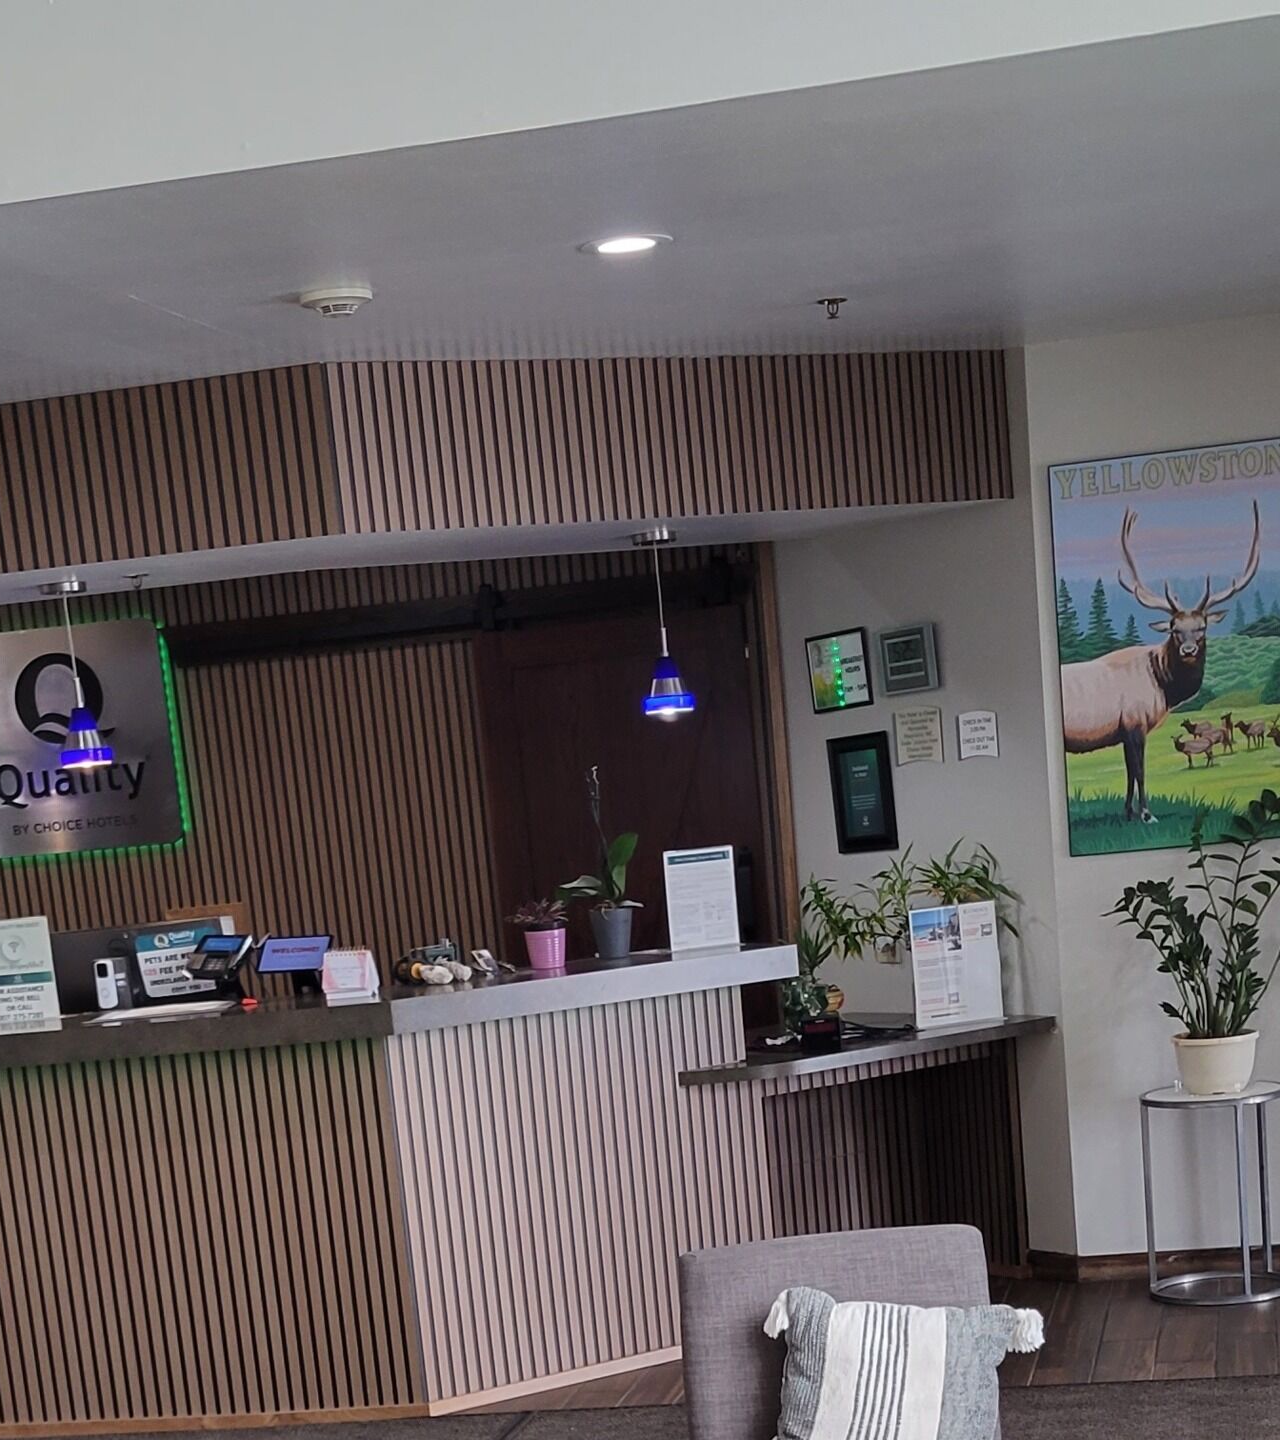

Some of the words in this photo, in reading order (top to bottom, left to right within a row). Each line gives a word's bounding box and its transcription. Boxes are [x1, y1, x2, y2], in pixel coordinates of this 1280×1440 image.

[15, 653, 115, 745] Q
[13, 824, 29, 836] BY
[33, 818, 82, 834] CHOICE
[86, 814, 138, 829] HOTELS
[144, 956, 162, 965] PETS
[164, 954, 179, 963] ARE
[159, 966, 173, 975] FEE
